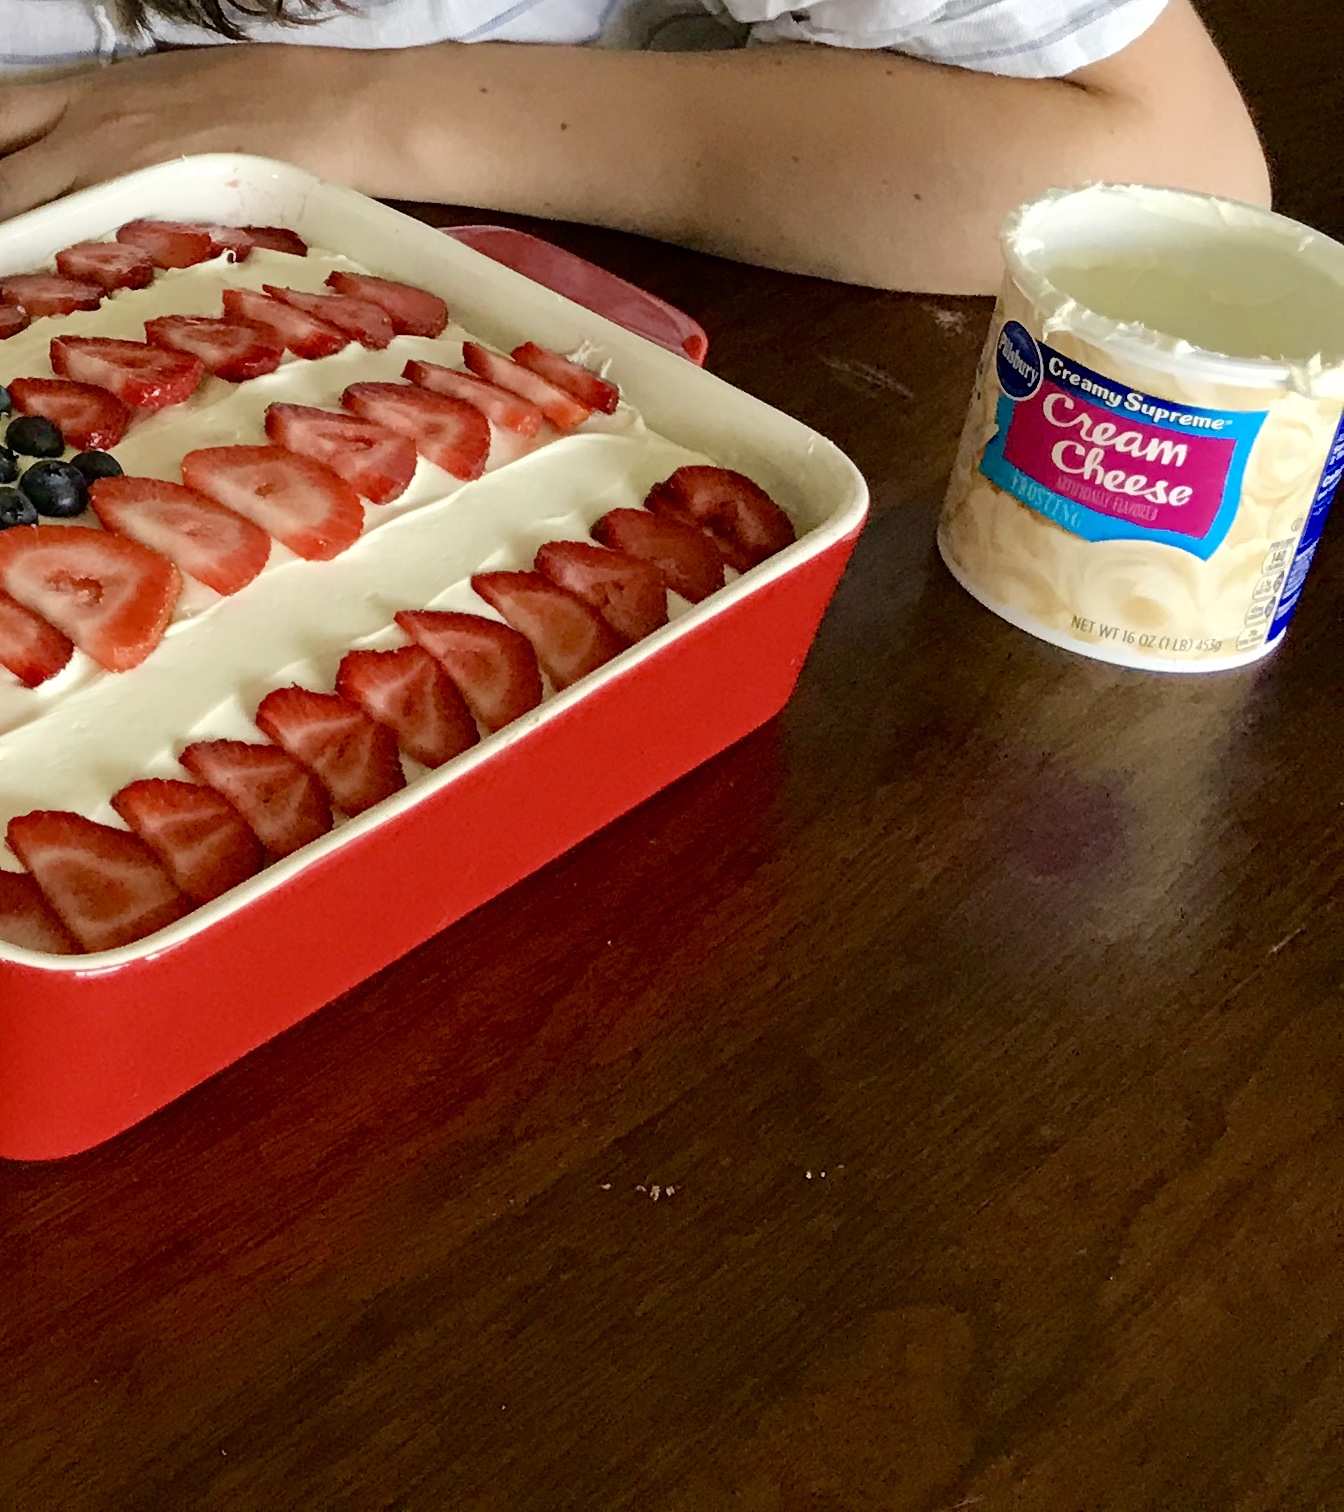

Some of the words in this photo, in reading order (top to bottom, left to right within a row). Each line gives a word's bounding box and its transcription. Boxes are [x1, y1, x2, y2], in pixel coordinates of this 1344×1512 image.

[1048, 356, 1123, 408] Creamy
[1123, 392, 1226, 431] Supreme
[1043, 393, 1189, 467] Cream
[1011, 466, 1083, 529] FROSTING
[1051, 440, 1193, 507] Cheese
[1070, 614, 1096, 634] NET
[1099, 623, 1120, 640] WT
[1122, 629, 1136, 645] 16
[1138, 634, 1158, 650] OZ
